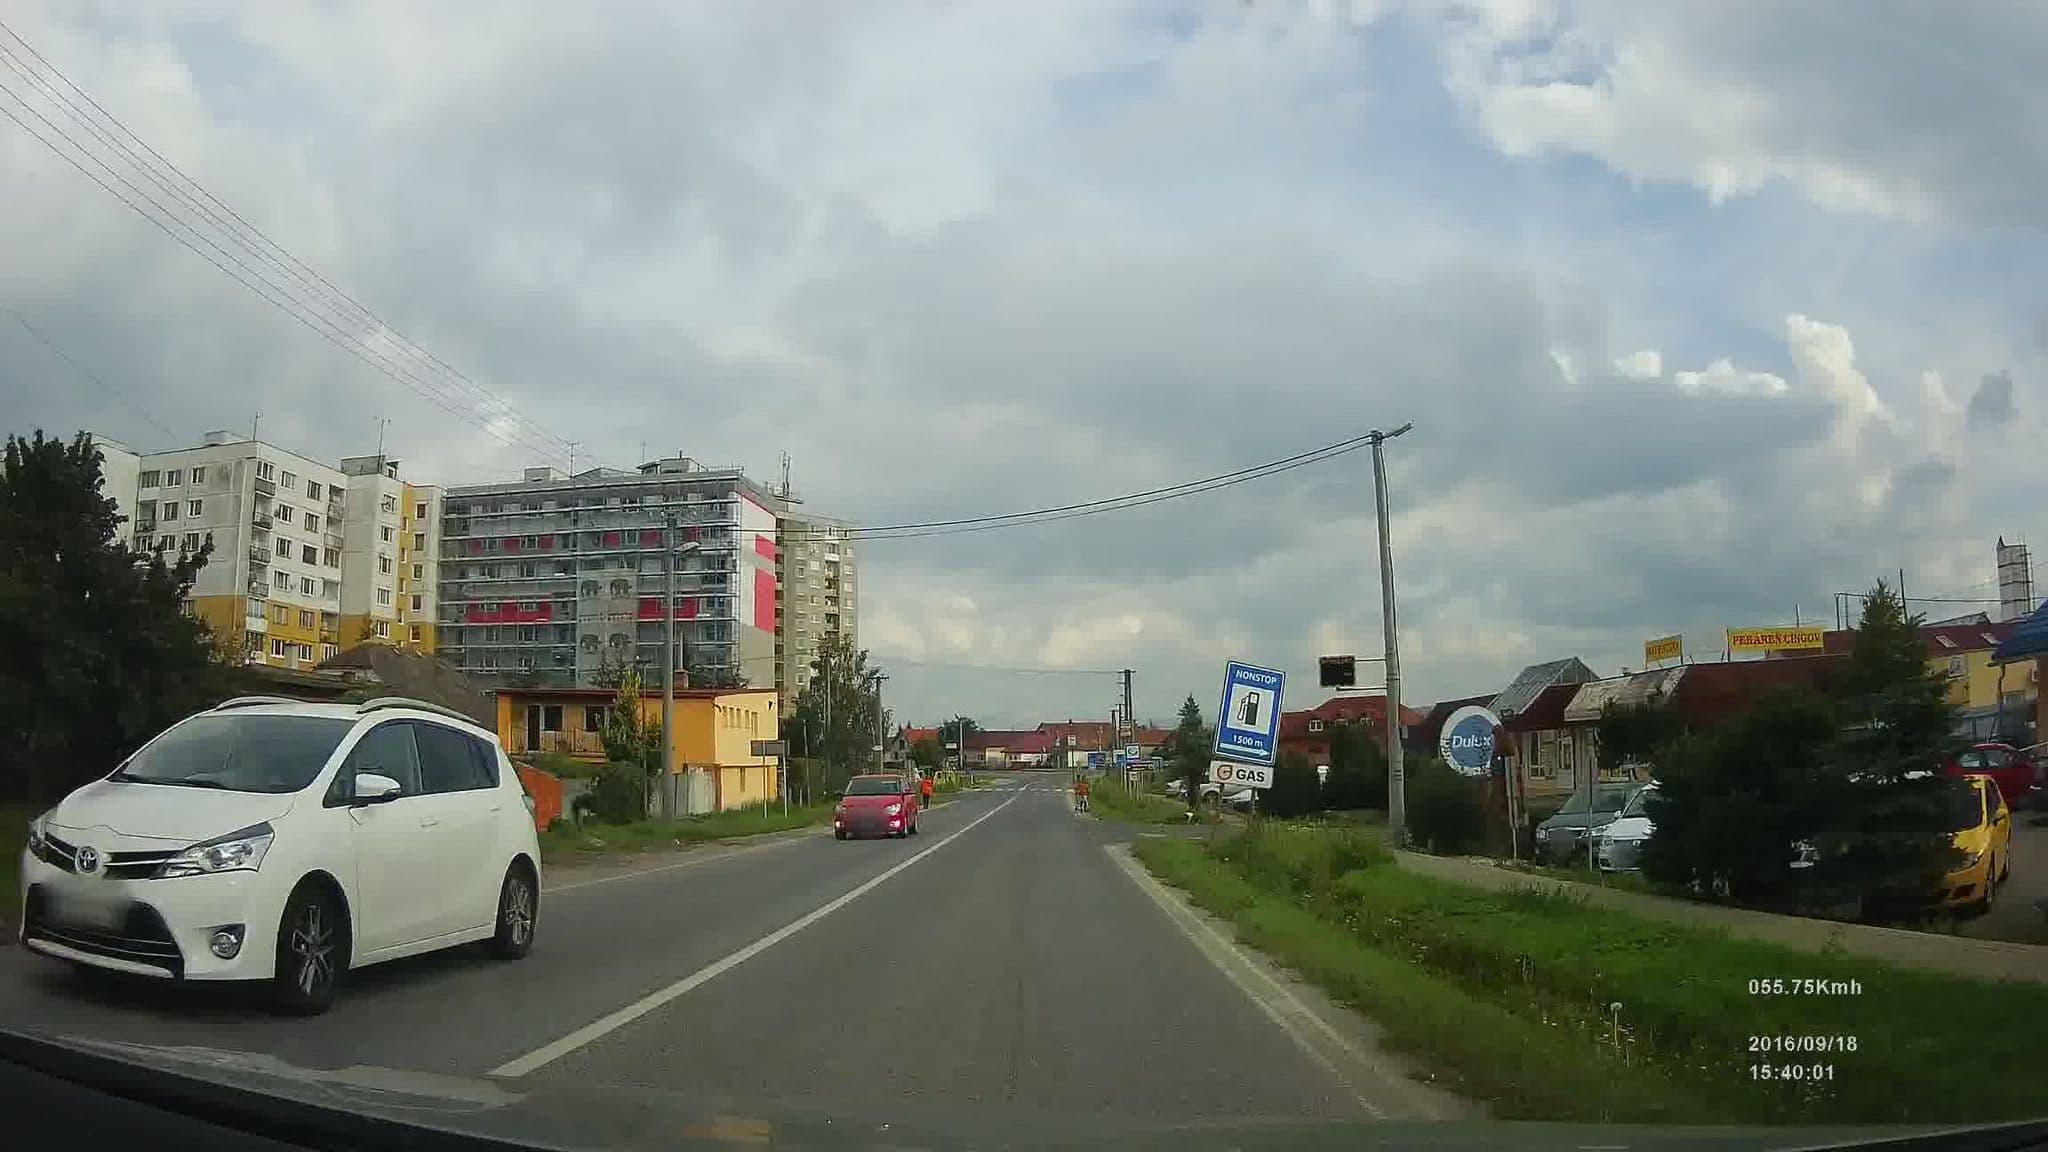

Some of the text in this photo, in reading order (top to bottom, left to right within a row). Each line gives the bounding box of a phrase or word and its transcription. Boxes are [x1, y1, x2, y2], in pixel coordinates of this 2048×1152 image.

[1235, 669, 1277, 685] NONSTOP
[1232, 734, 1263, 747] 1500 m
[1236, 768, 1266, 783] GAS
